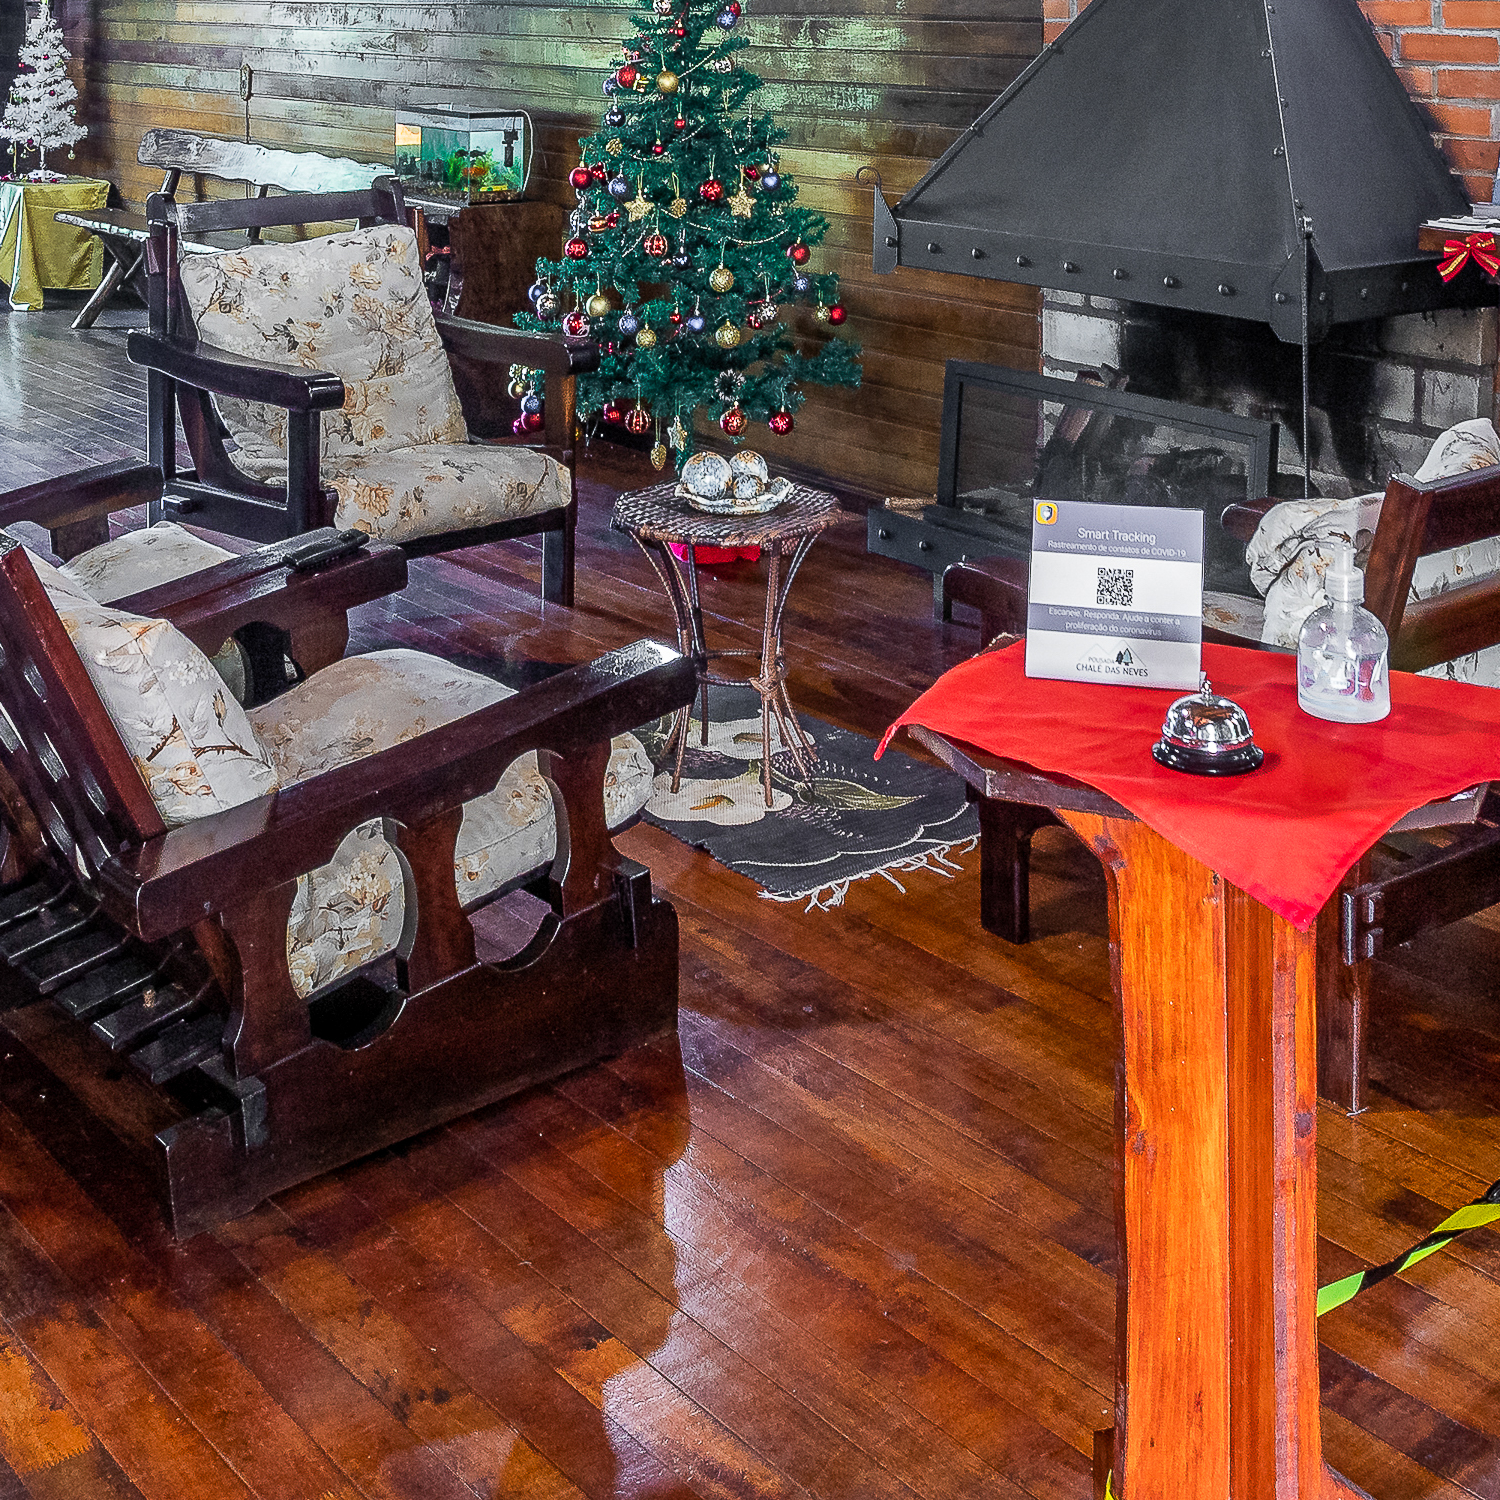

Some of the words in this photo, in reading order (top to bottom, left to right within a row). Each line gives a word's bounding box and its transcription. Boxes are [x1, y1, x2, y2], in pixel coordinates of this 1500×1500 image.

[1077, 527, 1110, 540] Smart
[1112, 529, 1157, 546] Tracking
[1048, 539, 1098, 551] Rastreamento
[1098, 544, 1108, 553] de
[1108, 545, 1139, 554] contatos
[1140, 547, 1150, 555] de
[1151, 547, 1187, 558] COVID-19
[1048, 607, 1081, 618] Escaneie.
[1083, 609, 1121, 621] Responda.
[1122, 613, 1143, 623] Ajude
[1150, 616, 1175, 625] conter
[1174, 618, 1181, 626] a
[1065, 621, 1108, 632] proliferação
[1108, 623, 1120, 632] do
[1104, 664, 1121, 675] DAS
[1122, 667, 1149, 678] NEVES
